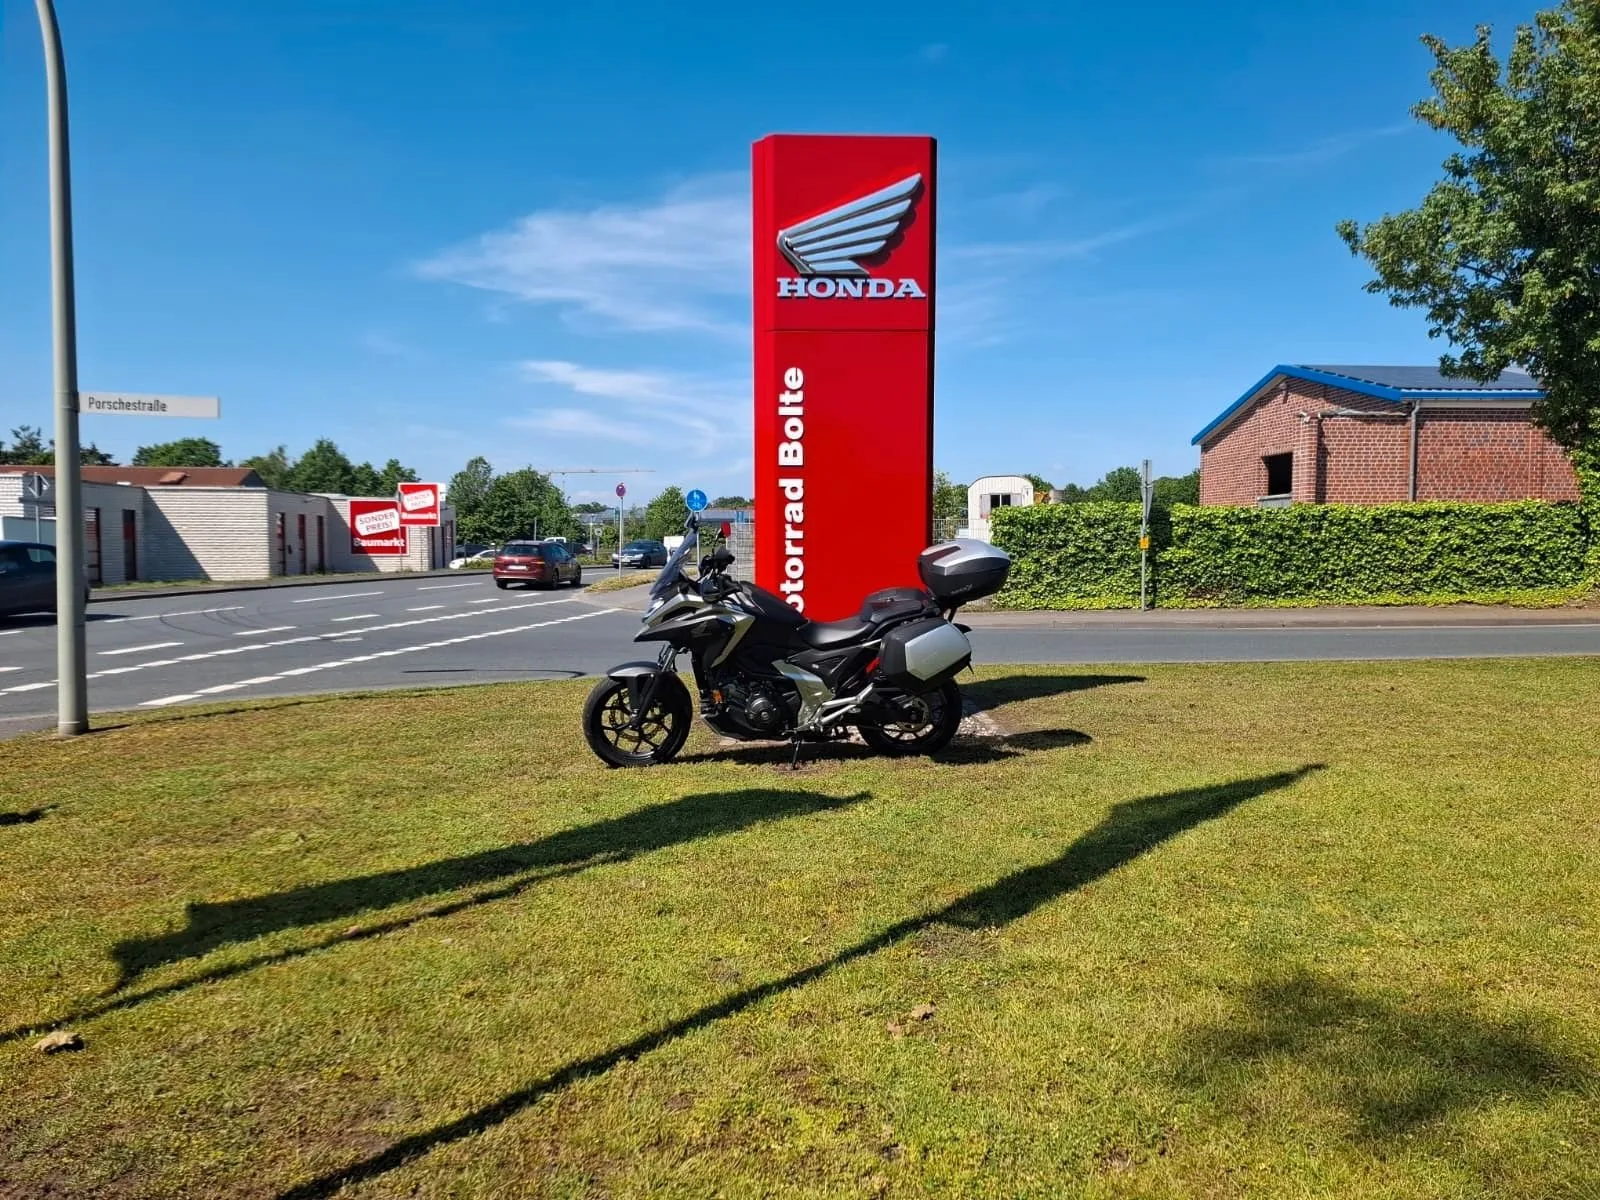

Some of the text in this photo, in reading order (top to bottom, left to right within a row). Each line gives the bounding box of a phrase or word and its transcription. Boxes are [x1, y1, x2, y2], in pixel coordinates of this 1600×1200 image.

[776, 277, 927, 298] HONDA
[88, 396, 168, 412] Porschestraße
[778, 367, 804, 614] otorrad Bolte
[359, 511, 395, 525] SONDER
